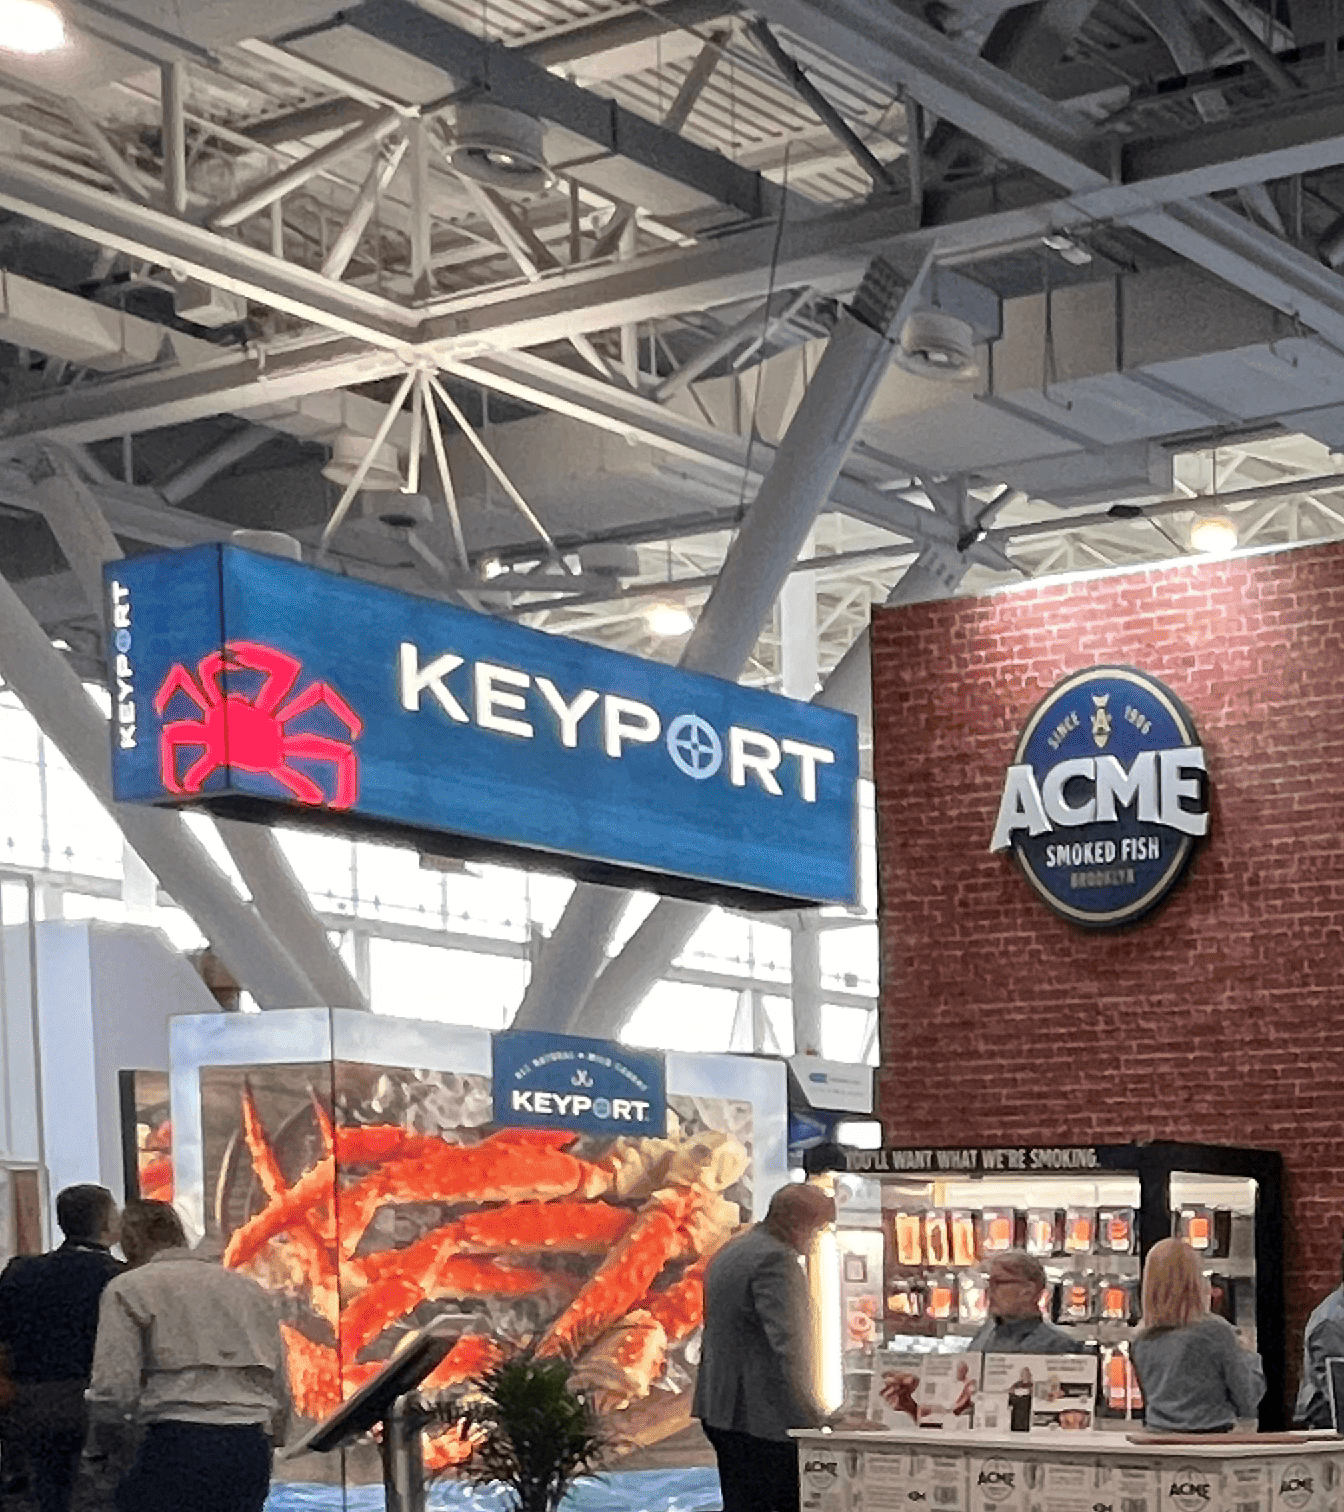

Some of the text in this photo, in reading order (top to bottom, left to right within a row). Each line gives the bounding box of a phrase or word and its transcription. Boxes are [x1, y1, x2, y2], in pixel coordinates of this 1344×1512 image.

[111, 581, 137, 749] KEYPORT
[399, 642, 836, 802] KEYPORT
[989, 746, 1209, 853] ACME
[1046, 837, 1160, 867] SMOKED FISH
[512, 1089, 650, 1122] KEYPORT
[937, 1149, 977, 1169] WHAT
[1169, 1482, 1211, 1501] ACME
